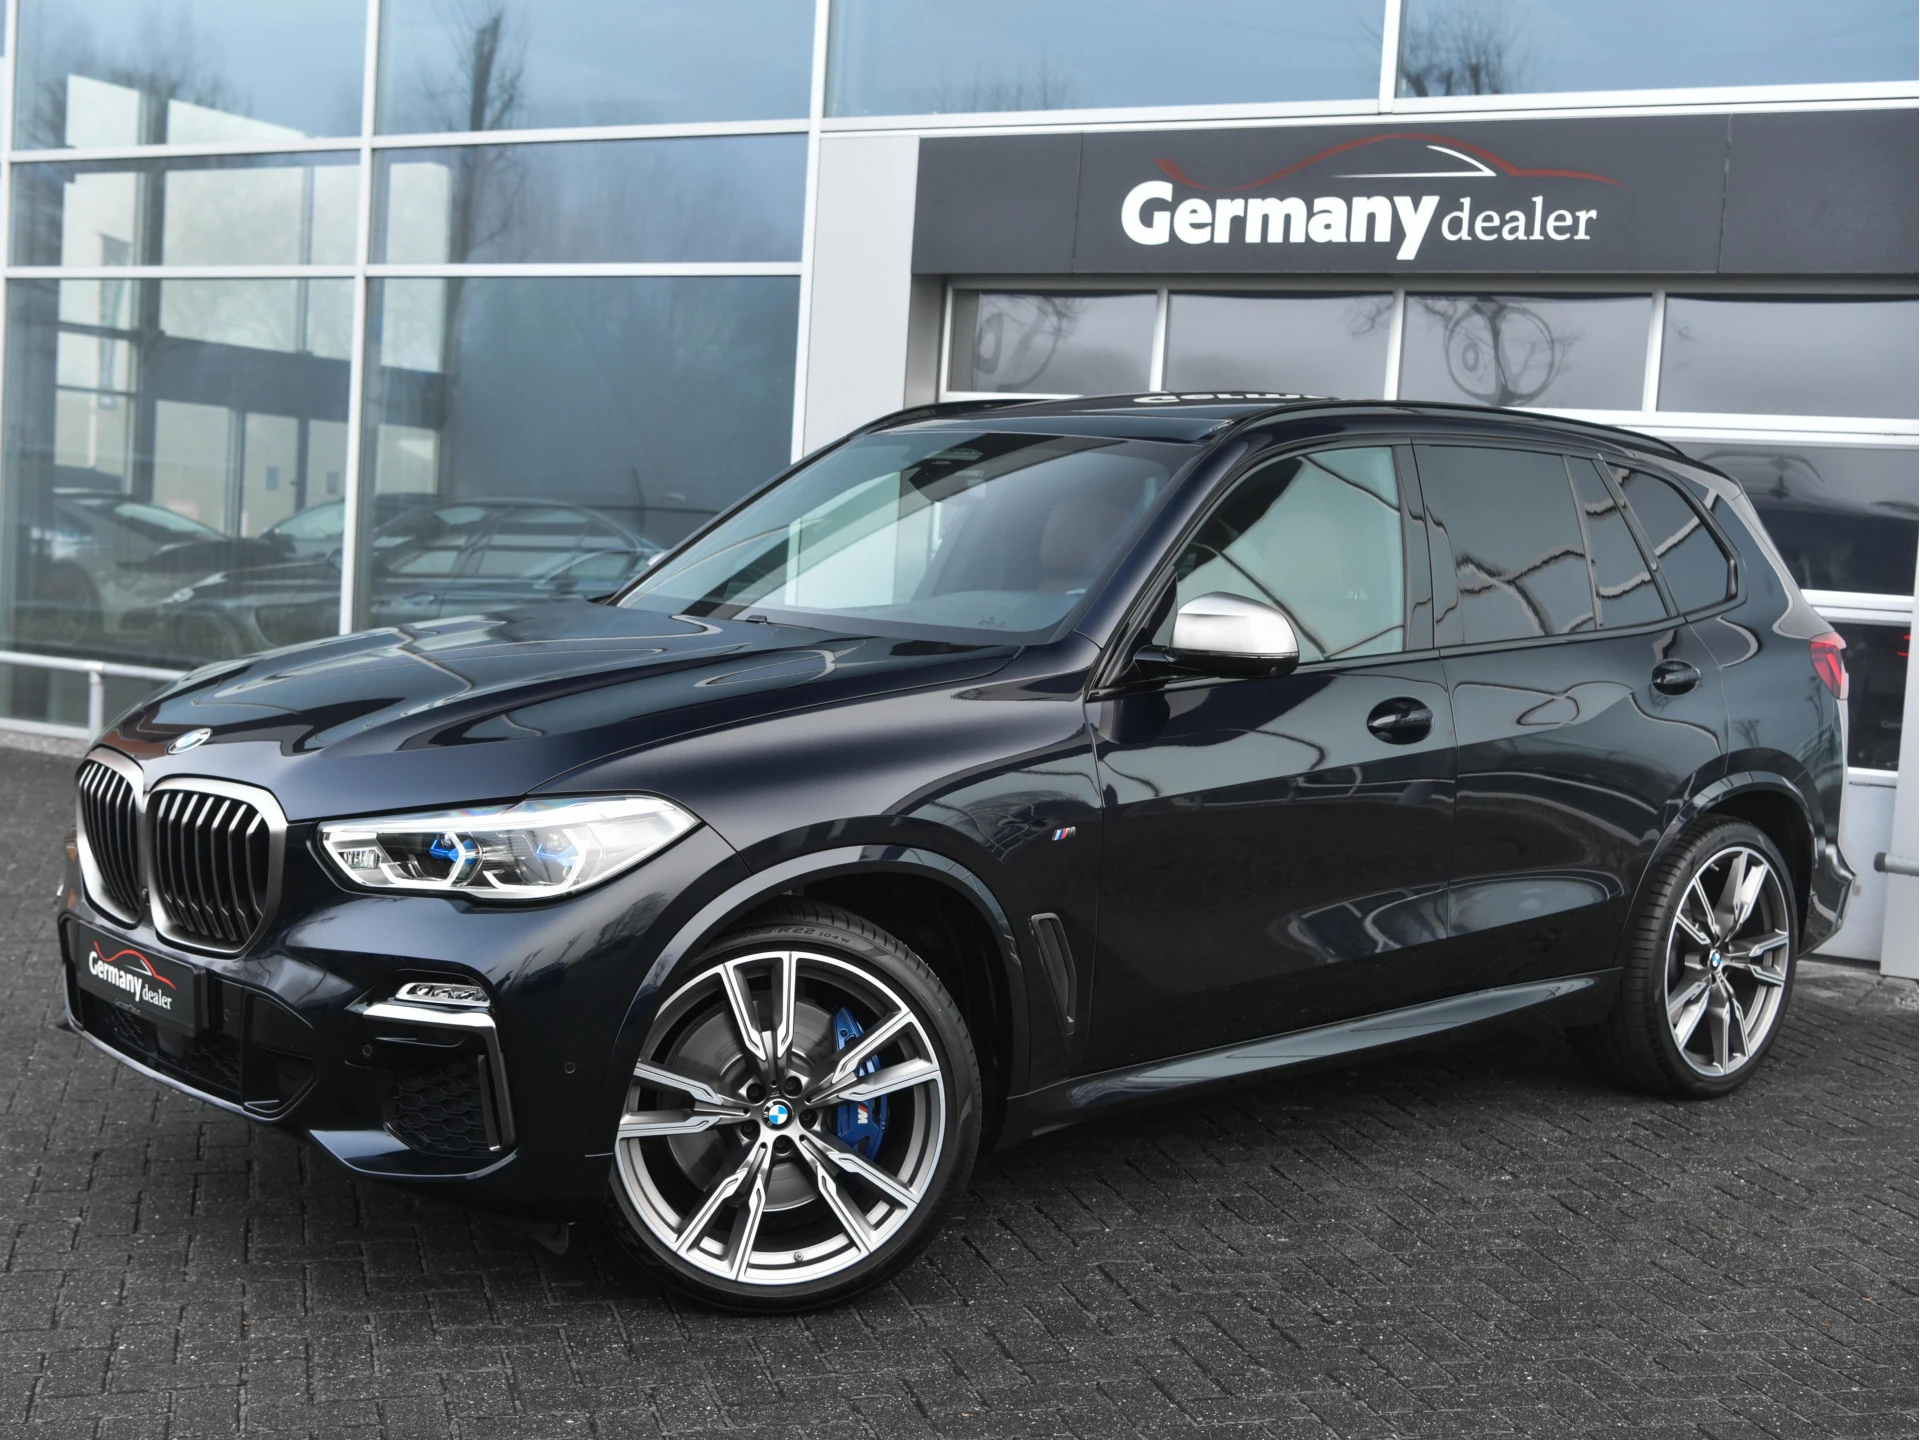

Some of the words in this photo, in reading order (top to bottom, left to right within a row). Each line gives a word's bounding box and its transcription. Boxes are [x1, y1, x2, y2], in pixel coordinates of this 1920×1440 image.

[1121, 180, 1441, 261] Germany
[1441, 196, 1598, 241] dealer
[88, 950, 142, 1002] Germany
[142, 985, 173, 1010] dealer
